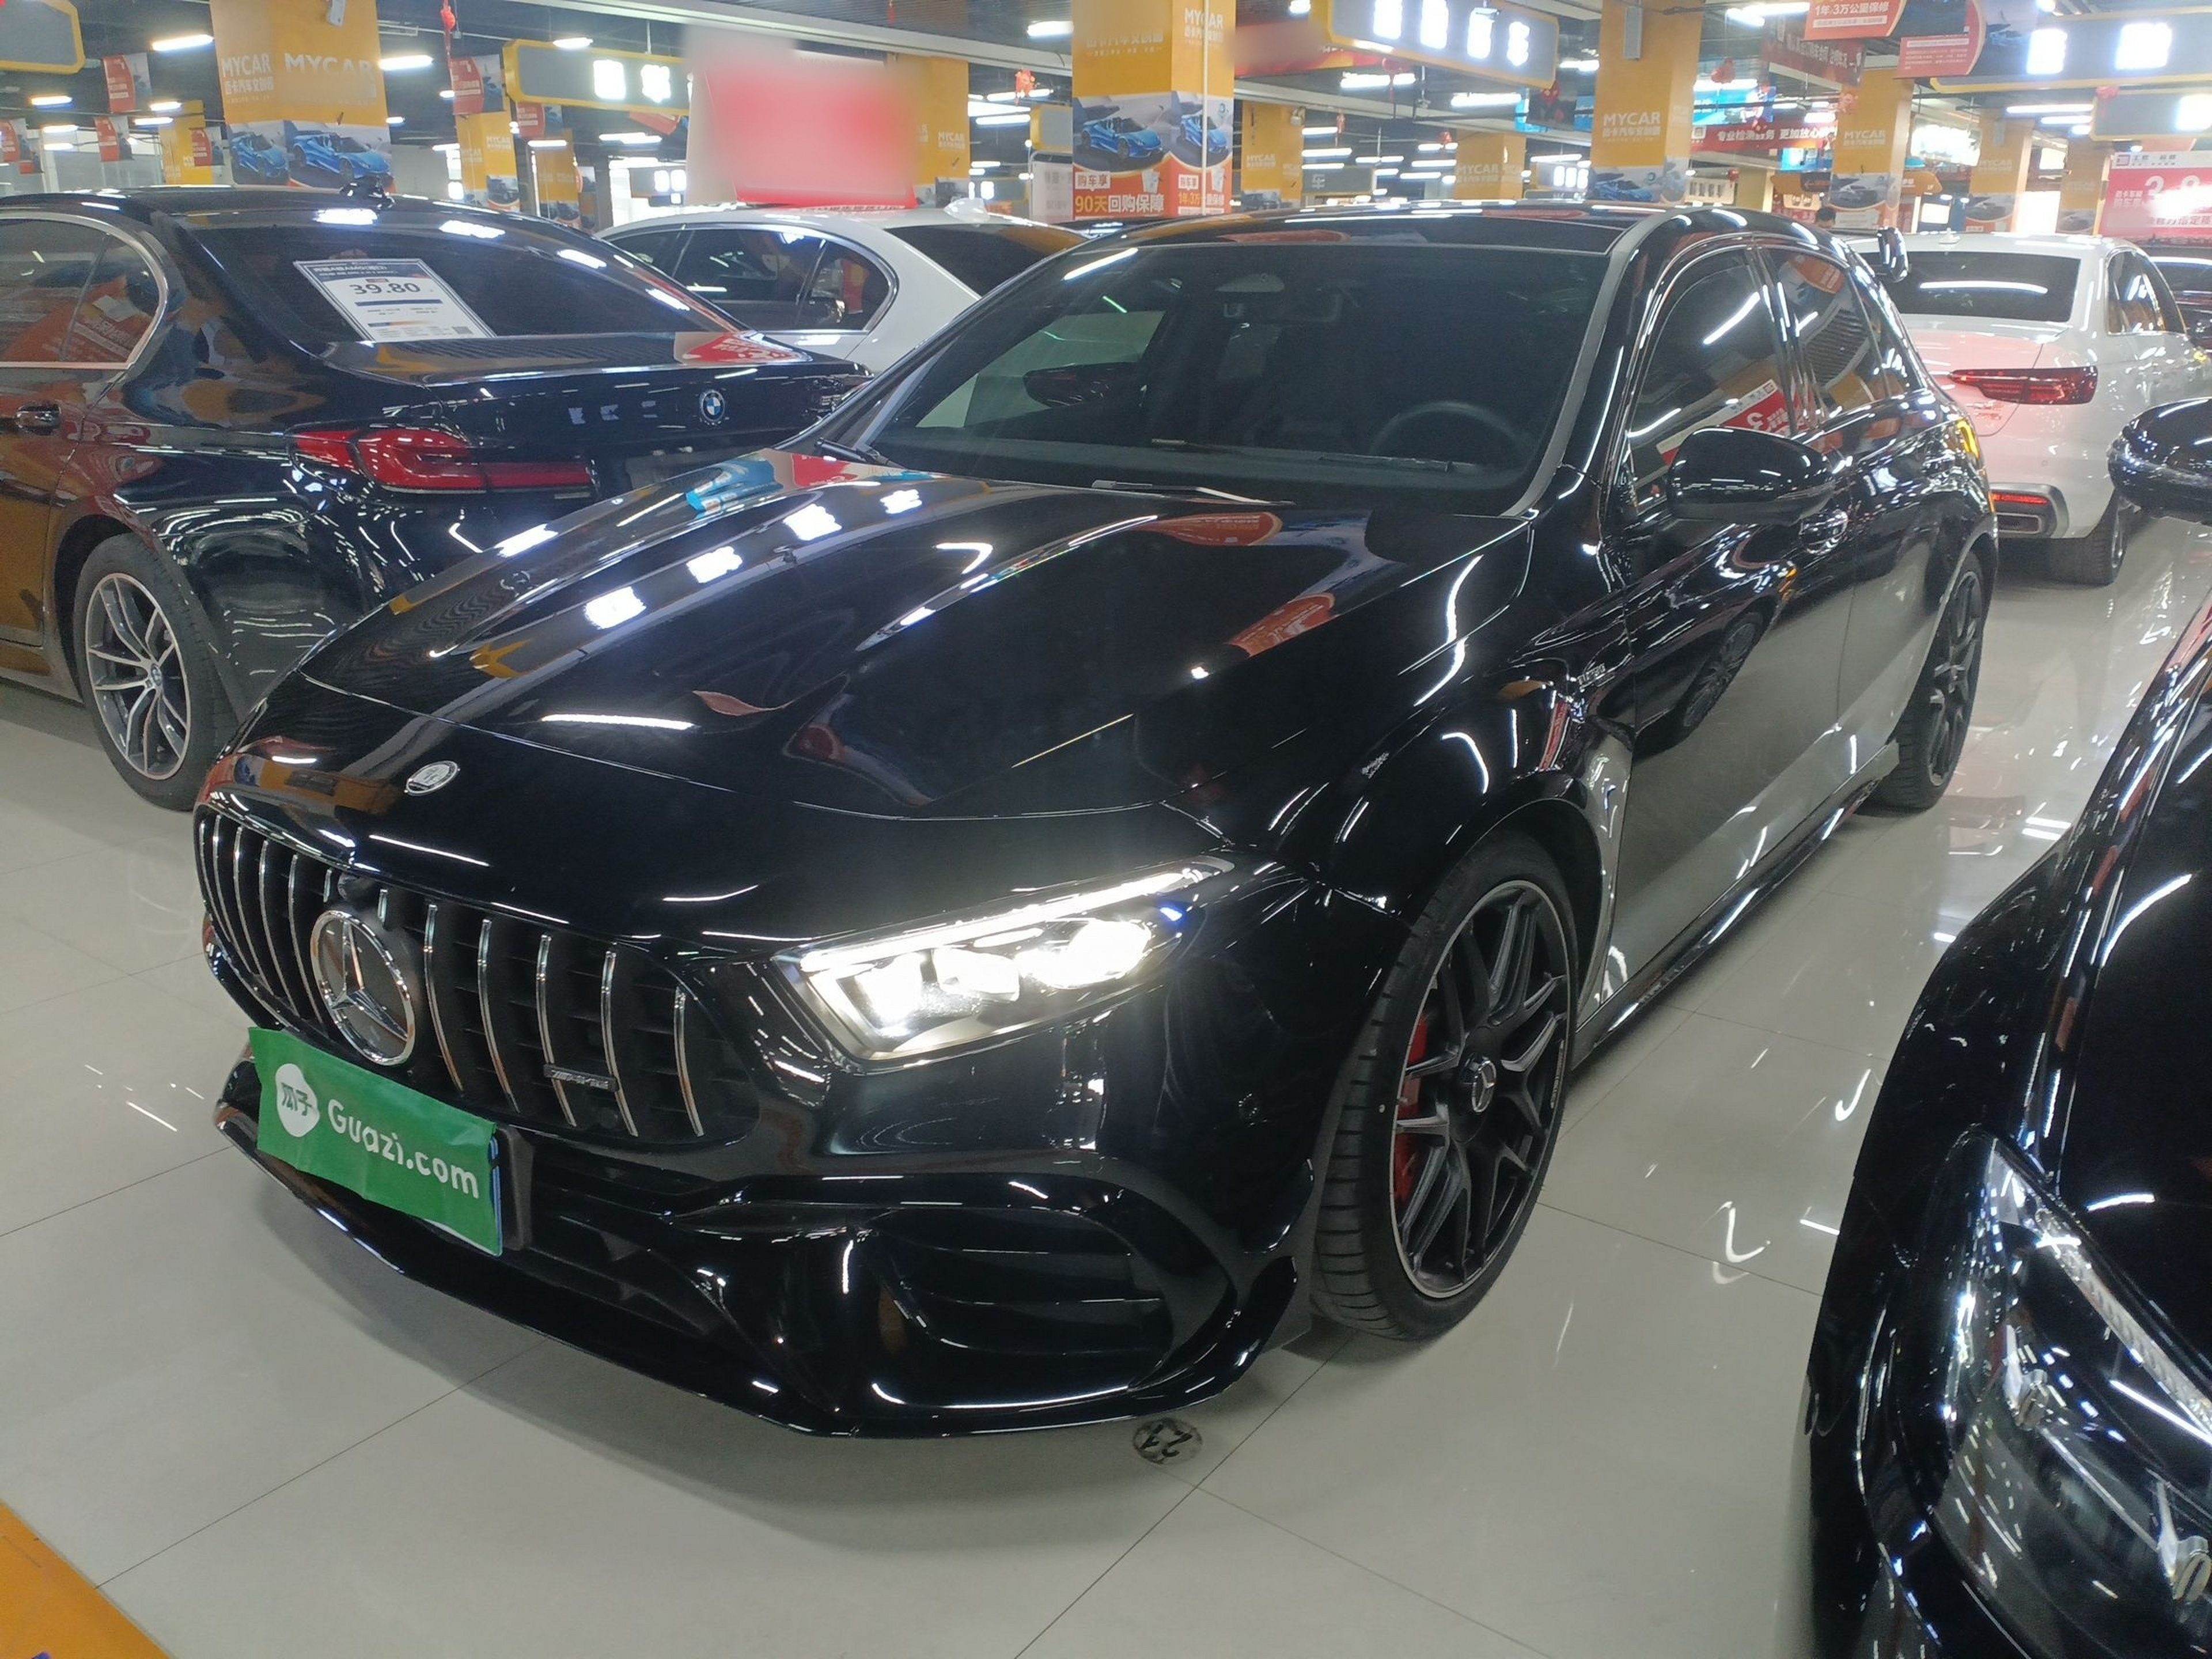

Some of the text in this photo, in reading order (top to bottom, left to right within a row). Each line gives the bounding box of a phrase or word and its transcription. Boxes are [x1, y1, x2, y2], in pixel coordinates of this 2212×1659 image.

[221, 53, 271, 77] MYCAR
[285, 53, 374, 81] MYCAR
[1603, 111, 1661, 126] MYCAR
[1844, 130, 1886, 139] MYCAR
[1075, 194, 1164, 213] 90天回购保障
[349, 282, 421, 295] 39.80
[281, 1082, 479, 1199] 瓜子 Guazi.com
